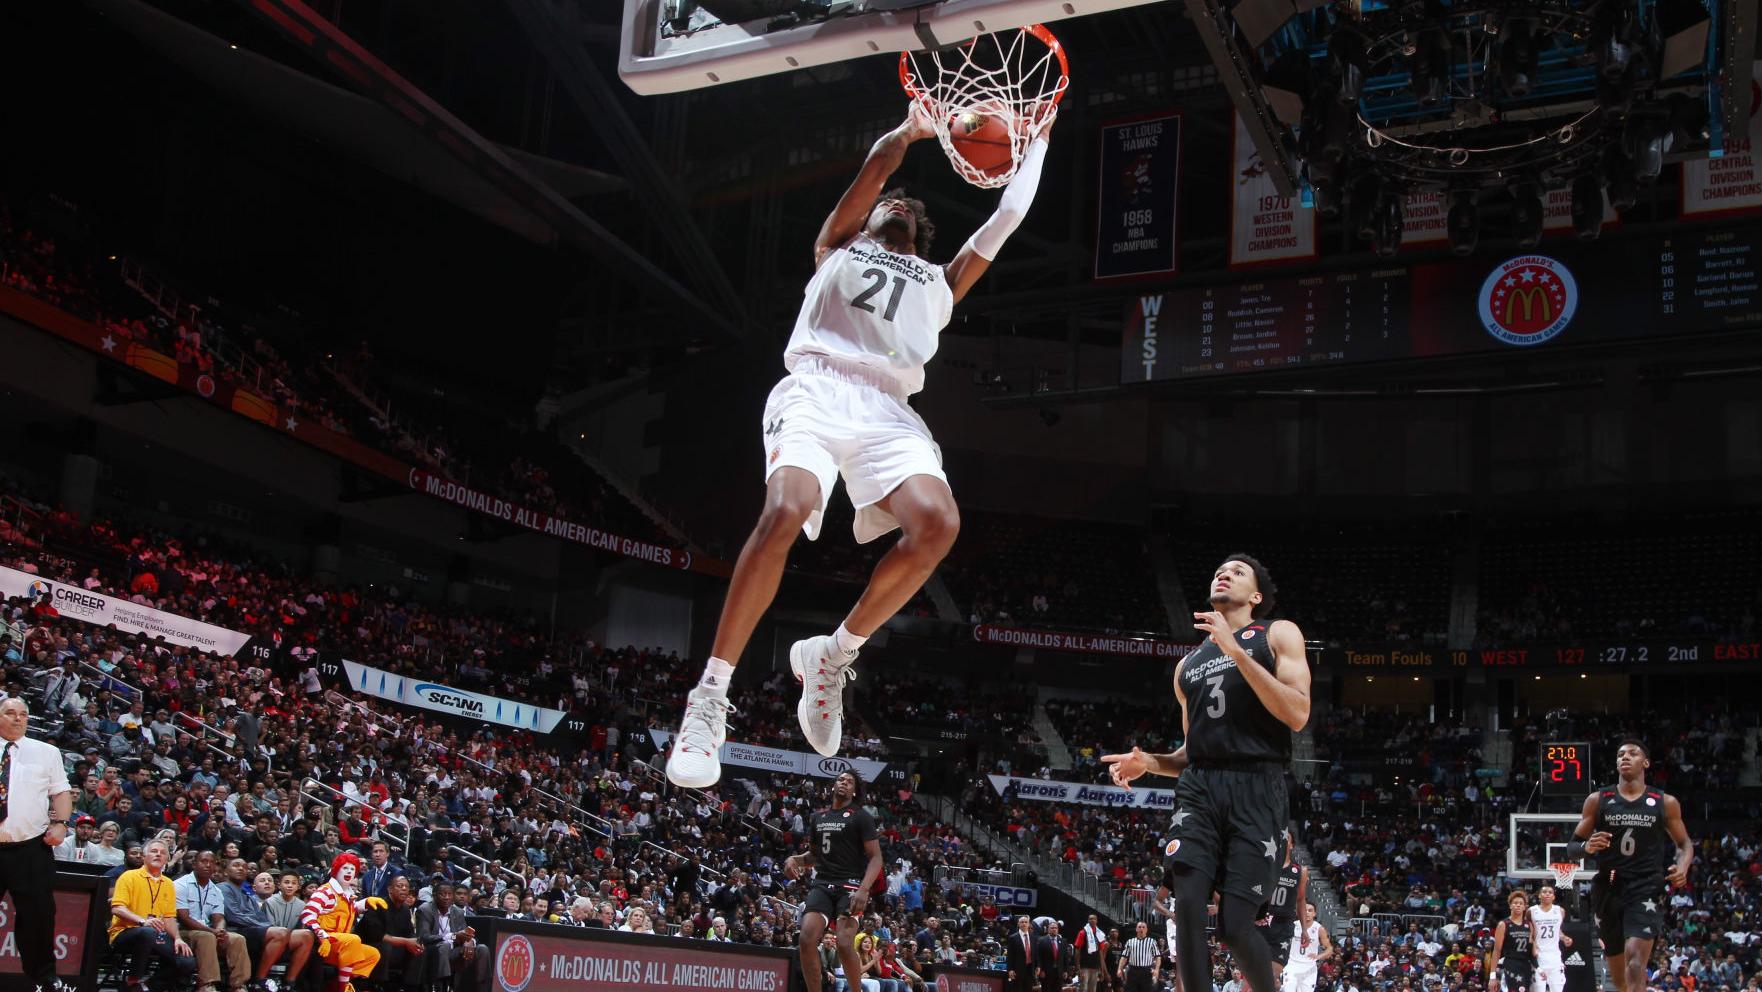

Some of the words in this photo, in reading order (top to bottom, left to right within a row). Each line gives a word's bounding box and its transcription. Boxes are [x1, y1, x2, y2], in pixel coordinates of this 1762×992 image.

[1119, 128, 1132, 140] ST.
[1135, 123, 1163, 137] LOUIS
[1123, 136, 1158, 152] HAWKS
[1709, 155, 1754, 170] CENTRAL
[1711, 169, 1754, 184] DIVISION
[1702, 183, 1762, 200] CHAMPIONS
[1258, 195, 1290, 211] 1970
[1122, 209, 1153, 227] 1958
[1253, 211, 1294, 225] WESTERN
[1406, 205, 1440, 218] IVISION
[1127, 227, 1145, 238] NBA
[1255, 224, 1291, 238] DIVISION
[1112, 238, 1159, 254] CHAMPIONS
[1248, 237, 1297, 252] CHAMPIONS
[849, 246, 935, 282] McDONALD'S
[1503, 257, 1554, 272] McDONALD'S
[1661, 253, 1674, 262] 05
[851, 256, 871, 265] ALL
[873, 260, 927, 286] AMERICAN
[1661, 265, 1674, 274] 06
[1663, 279, 1674, 287] 10
[850, 268, 907, 322] 21
[1662, 291, 1674, 301] 22
[1202, 301, 1214, 310] 00
[1663, 304, 1674, 314] 31
[1202, 313, 1213, 321] 08
[1140, 294, 1163, 380] WEST
[1202, 325, 1212, 334] 10
[1489, 323, 1501, 335] ALL
[1501, 332, 1543, 343] AMERICAN
[1543, 316, 1568, 335] GAMES
[1202, 336, 1211, 345] 21
[1201, 349, 1212, 357] 23
[425, 475, 512, 520] McDONALDS
[514, 507, 541, 531] ALL
[544, 517, 619, 552] AMERICAN
[622, 538, 672, 566] GAMES
[56, 587, 105, 611] CAREER
[54, 600, 96, 617] BUILDER
[115, 607, 136, 618] Helping
[136, 611, 165, 625] Employers
[130, 619, 145, 629] HIRE
[149, 624, 176, 637] MANAGE
[176, 631, 195, 641] GREAT
[195, 636, 217, 646] TALENT
[988, 628, 1061, 647] McDONALDS
[1064, 637, 1153, 655] ALL-AMERICAN
[252, 645, 270, 659] 116
[1346, 651, 1386, 665] Team
[1391, 651, 1433, 665] Fouls
[1451, 652, 1467, 666] 10
[1481, 651, 1528, 665] WEST
[1556, 649, 1585, 664] 127
[1667, 646, 1698, 661] 2nd
[1714, 643, 1762, 660] EAST
[321, 662, 338, 676] 117
[1190, 673, 1204, 684] ALL
[1204, 661, 1237, 677] AMERIC
[428, 691, 485, 713] SCANA
[1206, 674, 1226, 719] 3
[461, 710, 483, 719] ENERGY
[568, 720, 585, 731] 117
[629, 732, 645, 743] 118
[730, 747, 753, 756] OFFICIAL
[754, 750, 775, 758] VEHICLE
[1547, 747, 1576, 760] 27.0
[743, 755, 771, 764] ATLANTA
[771, 759, 794, 768] HAWKS
[824, 760, 846, 772] KIA
[889, 769, 905, 780] 118
[1552, 760, 1581, 781] 27
[1011, 780, 1066, 798] Aaron's
[1077, 785, 1136, 804] Aaron's
[1604, 814, 1657, 823] McDONALD'S
[822, 832, 831, 854] 5
[1620, 828, 1636, 856] 6
[1270, 886, 1287, 906] 10
[1540, 925, 1554, 939] 23
[1515, 938, 1528, 952] 22
[551, 954, 641, 984] McDONALDS
[644, 962, 668, 985] ALL
[672, 963, 734, 989] AMERICAN
[737, 968, 776, 992] GAMES
